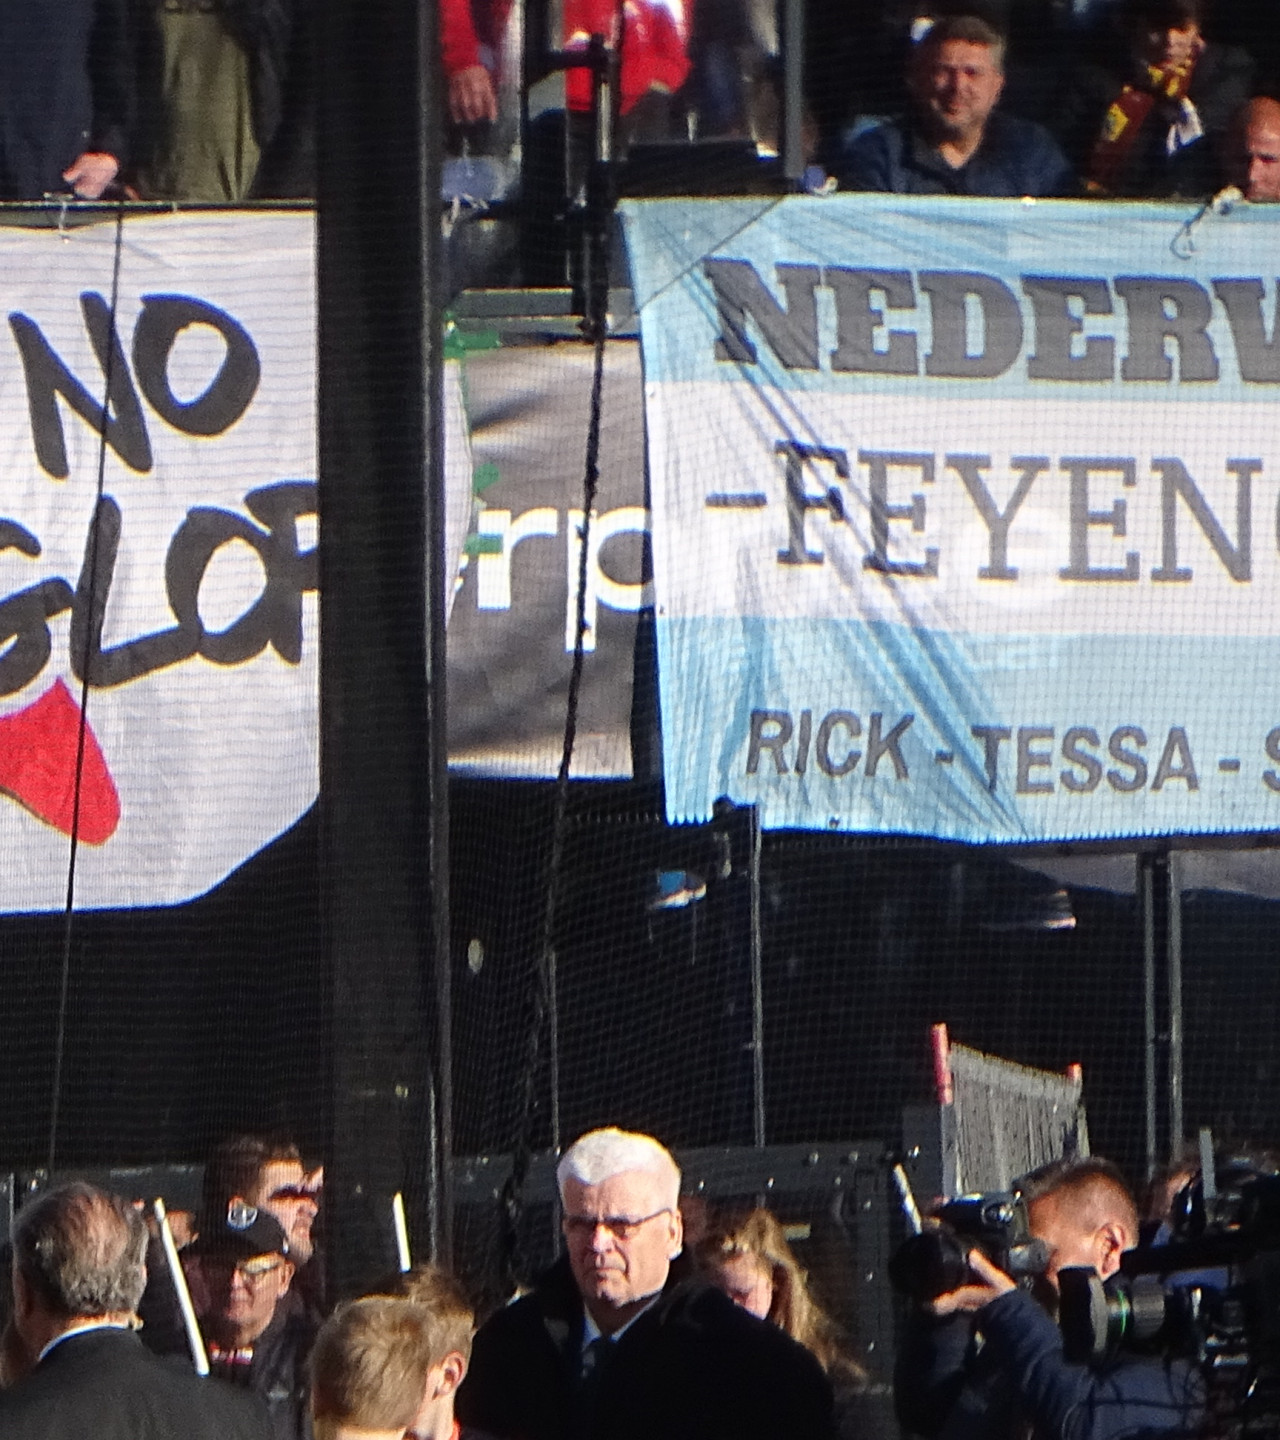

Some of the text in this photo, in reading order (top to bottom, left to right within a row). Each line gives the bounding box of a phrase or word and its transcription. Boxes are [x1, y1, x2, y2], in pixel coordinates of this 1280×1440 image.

[8, 290, 263, 480] NO
[705, 440, 1280, 582] -FEYEN
[746, 709, 914, 781] RICK
[973, 724, 1200, 797] TESSA
